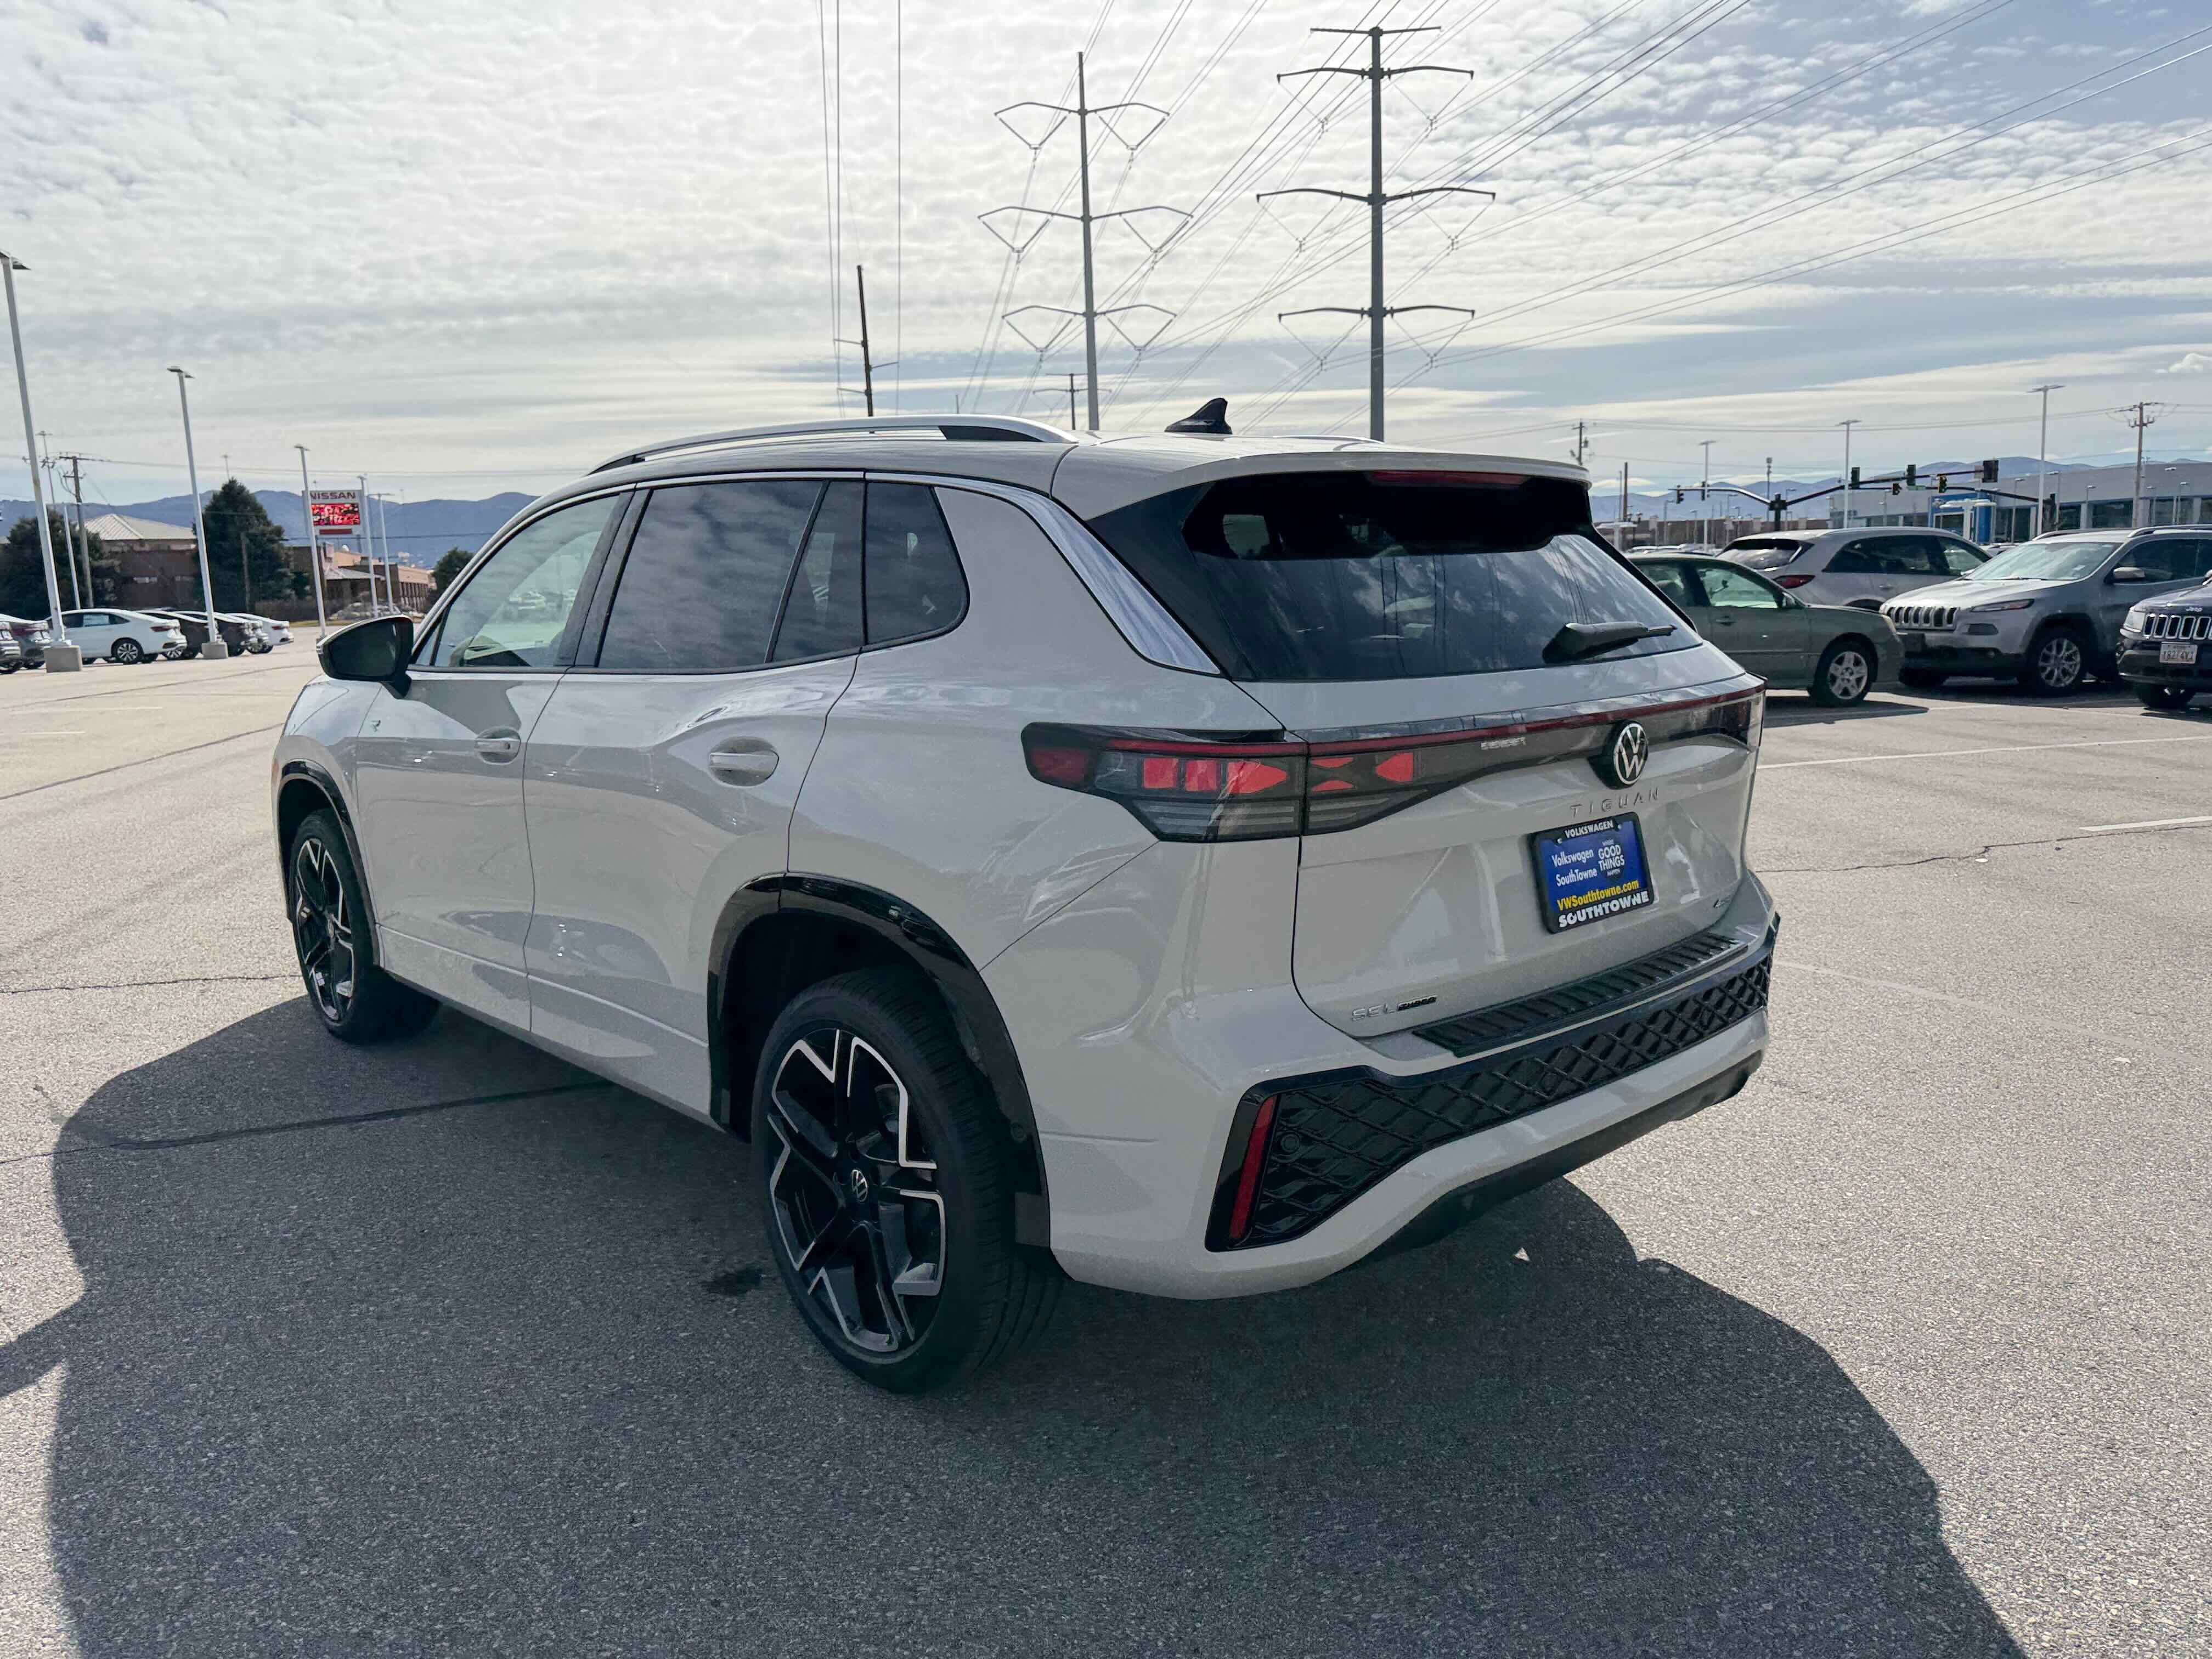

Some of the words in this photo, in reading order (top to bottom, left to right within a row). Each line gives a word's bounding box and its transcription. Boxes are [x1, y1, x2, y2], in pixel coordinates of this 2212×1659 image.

[310, 492, 356, 500] NISSAN
[1570, 786, 1659, 819] TIGUAN
[1565, 820, 1613, 838] VOLKSWAGEN
[1551, 849, 1594, 867] Volkswagen
[1598, 844, 1621, 860] GOOD
[1598, 855, 1625, 871] THINGS
[1556, 867, 1598, 887] SouthTowne
[1557, 880, 1639, 911] VWSouthtowne.com
[1558, 890, 1650, 928] SOUTHTOWNE
[1351, 1003, 1395, 1021] SEL
